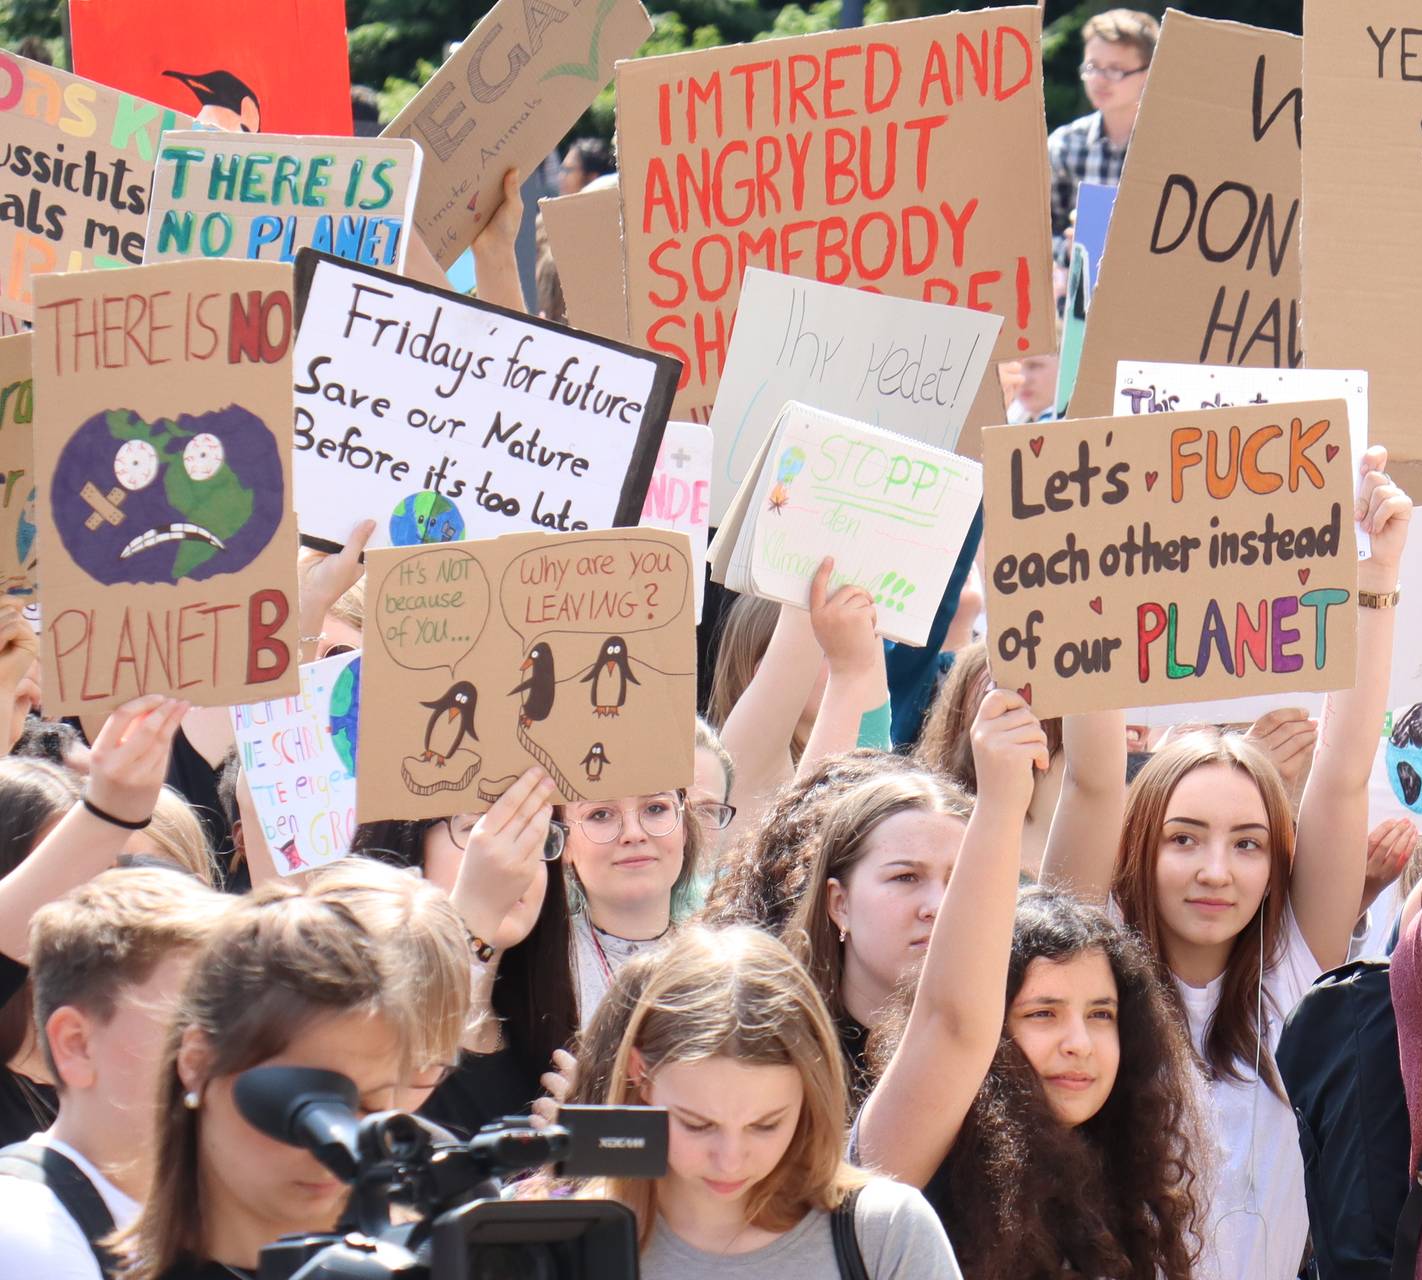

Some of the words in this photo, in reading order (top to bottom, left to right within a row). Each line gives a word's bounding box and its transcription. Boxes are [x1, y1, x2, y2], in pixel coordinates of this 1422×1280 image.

[658, 70, 723, 146] I'M
[730, 43, 902, 131] TIRED
[919, 26, 1033, 107] AND
[161, 145, 336, 207] THERE
[345, 156, 398, 211] IS
[642, 131, 813, 234] ANGRY
[825, 115, 950, 207] BUT
[157, 209, 234, 258] NO
[648, 199, 979, 310] SOMEBODY
[38, 290, 174, 376] THERE
[184, 292, 222, 362] IS
[227, 290, 293, 364] NO
[293, 355, 391, 418] Save
[406, 407, 467, 439] our
[481, 411, 590, 477] Nature
[502, 335, 546, 392] for
[548, 356, 643, 425] future
[293, 407, 411, 482] Before
[423, 455, 467, 498] it's
[475, 471, 521, 517] too
[530, 491, 589, 531] late
[810, 433, 962, 511] STOPPT
[1010, 431, 1131, 520] Let's
[1170, 417, 1331, 504] FUCK
[400, 560, 427, 586] It's
[436, 558, 473, 582] NOT
[520, 556, 570, 591] Why
[577, 554, 615, 576] are
[993, 532, 1091, 595] each
[1098, 520, 1201, 577] other
[1208, 502, 1342, 569] instead
[48, 602, 241, 702] PLANET
[244, 588, 290, 685] B
[385, 591, 464, 613] because
[386, 616, 407, 648] of
[998, 608, 1045, 671] of
[1053, 635, 1122, 679] our
[1136, 587, 1351, 684] PLANET
